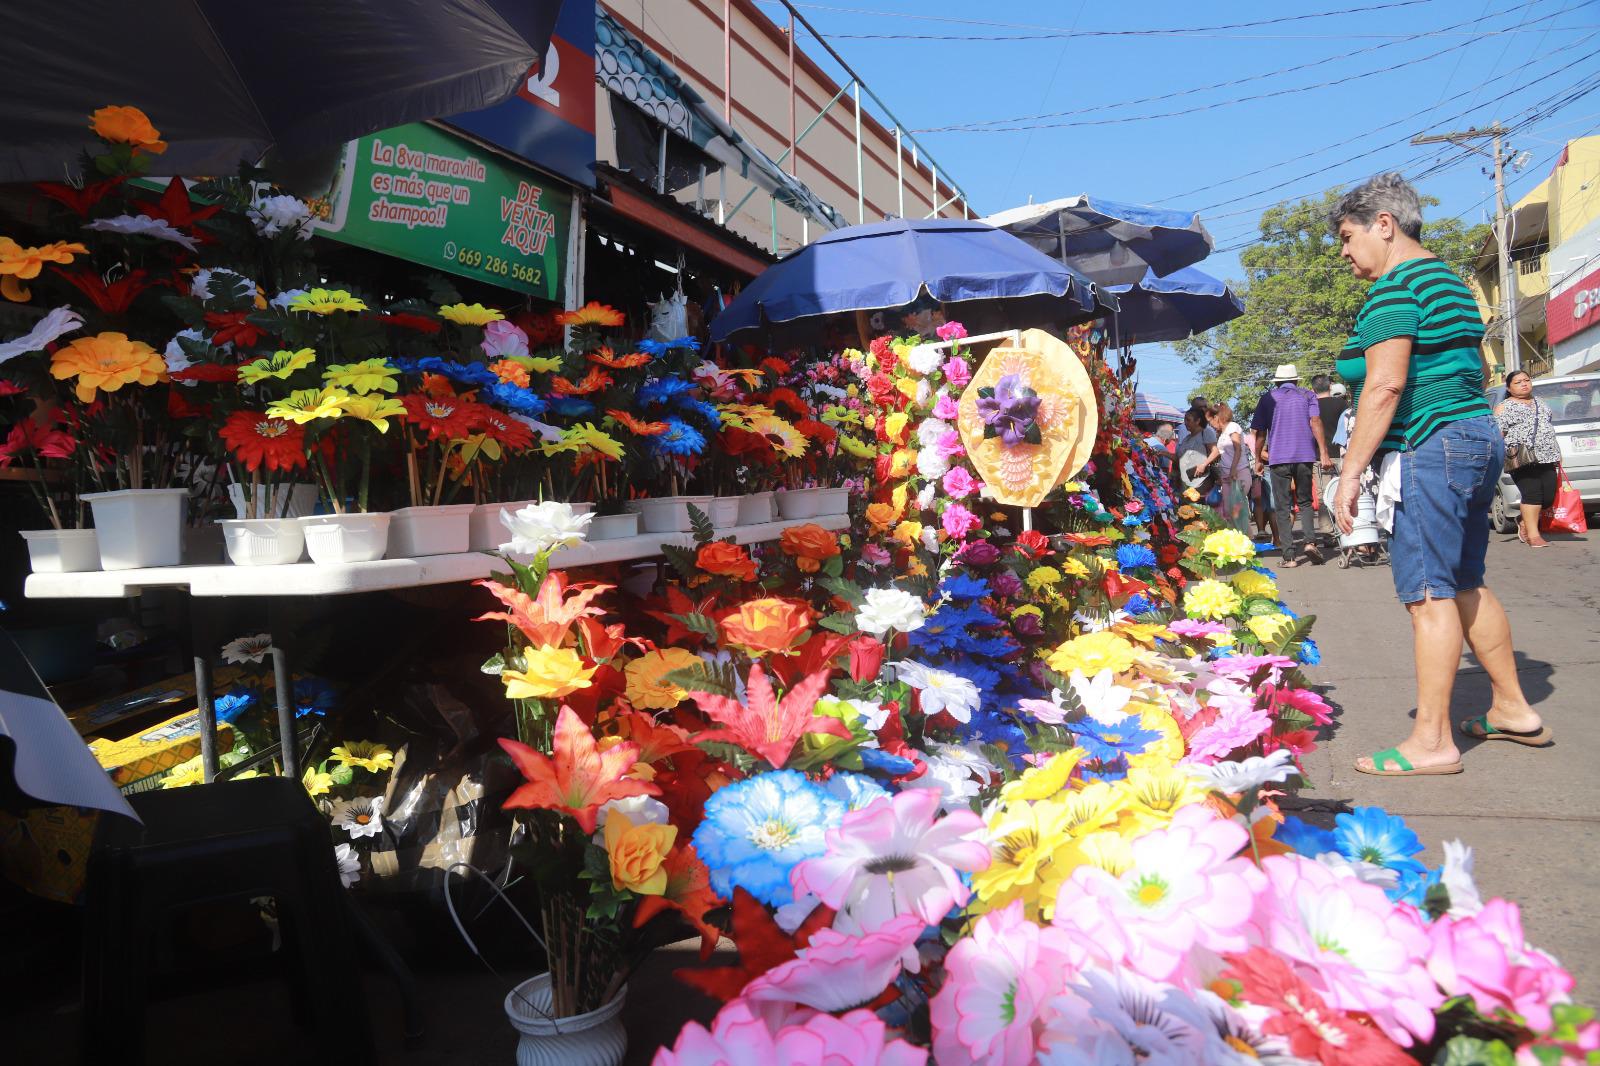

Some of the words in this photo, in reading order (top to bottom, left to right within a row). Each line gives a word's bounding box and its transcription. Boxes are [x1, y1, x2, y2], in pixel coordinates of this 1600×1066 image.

[372, 140, 393, 165] La
[397, 145, 423, 170] 8va
[425, 155, 485, 181] maravilla
[372, 174, 390, 192] es
[393, 173, 424, 197] más
[426, 182, 451, 204] que
[453, 186, 469, 204] un
[517, 182, 541, 209] DE
[370, 198, 447, 228] shampoo!!
[501, 197, 555, 236] VENTA
[502, 224, 547, 255] AQUI
[459, 248, 481, 267] 669
[485, 256, 508, 275] 286
[512, 263, 541, 284] 5682
[121, 773, 163, 796] REMIUM
